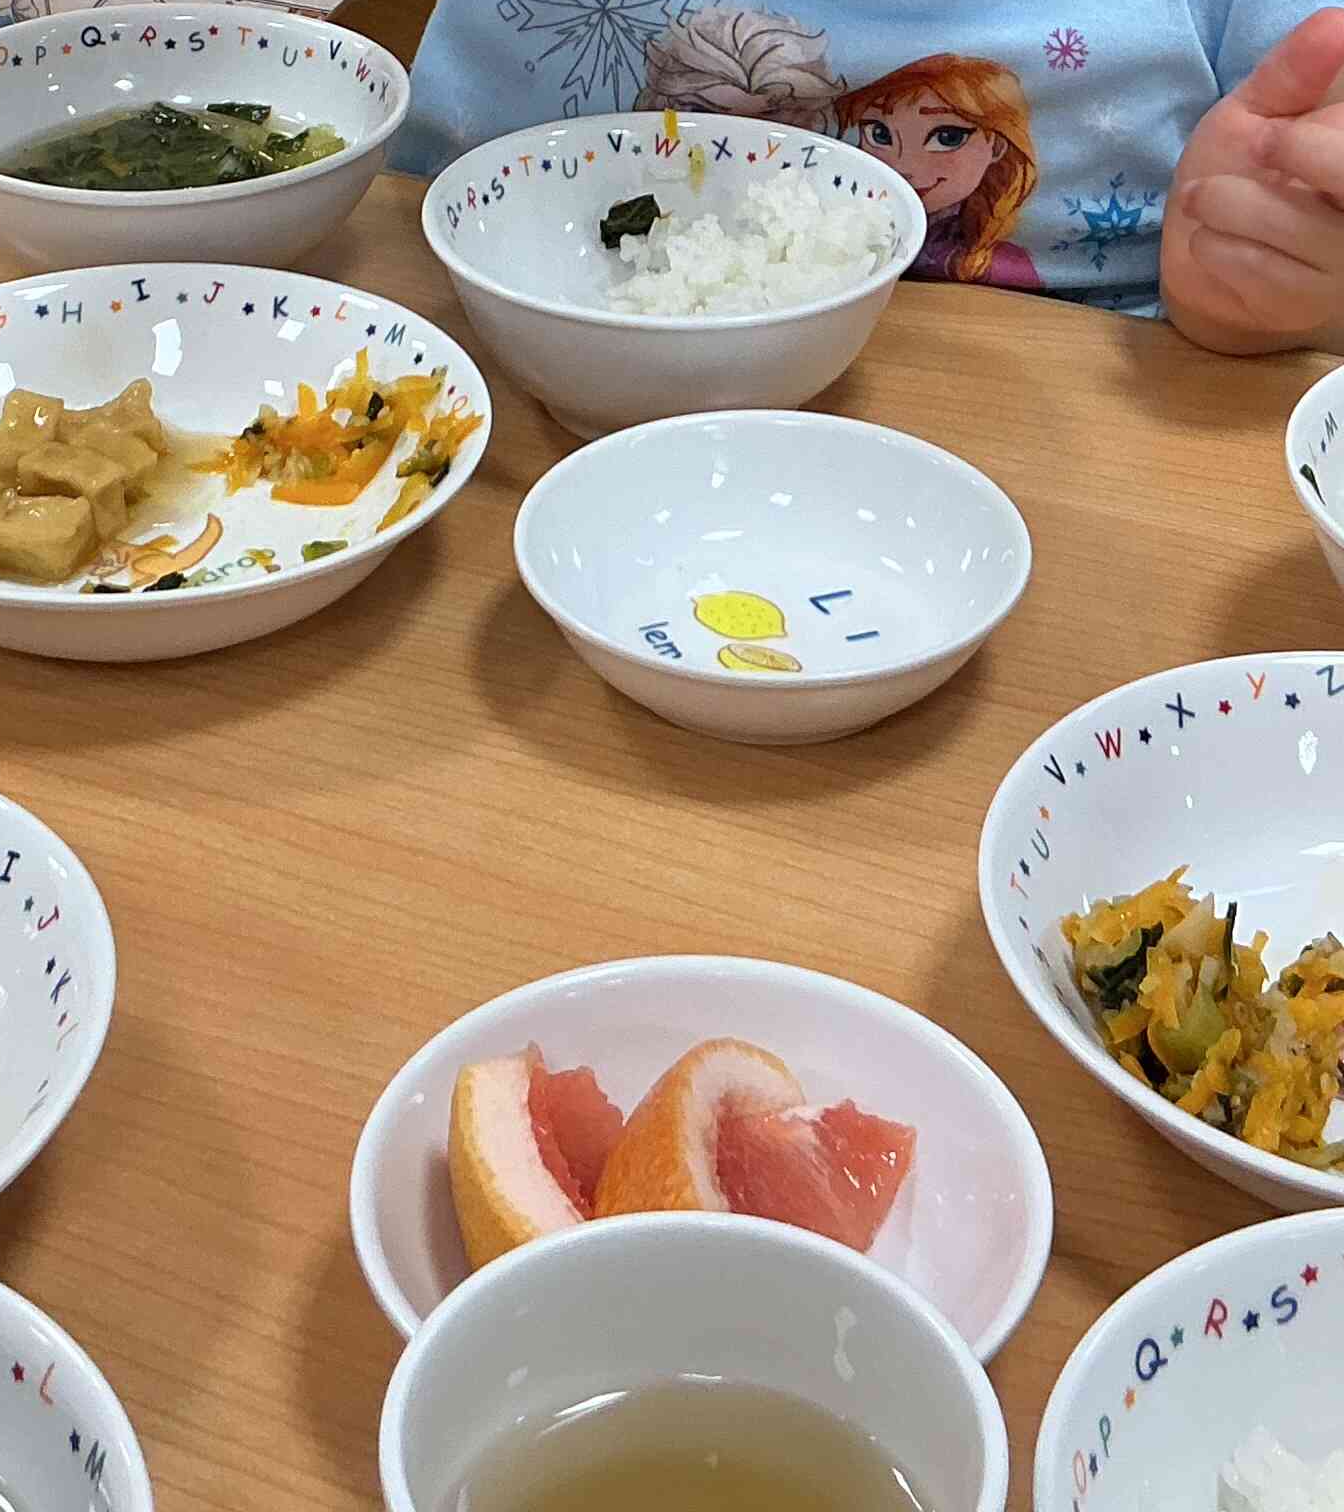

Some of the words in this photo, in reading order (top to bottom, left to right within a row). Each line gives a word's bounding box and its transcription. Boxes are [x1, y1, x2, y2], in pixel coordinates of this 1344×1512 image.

[36, 46, 46, 65] P
[81, 26, 106, 48] Q
[139, 26, 156, 47] R
[189, 32, 205, 52] S
[237, 27, 252, 46] T
[283, 46, 298, 67] U
[330, 40, 342, 60] V
[467, 187, 476, 209] R
[491, 177, 504, 200] S
[518, 156, 533, 176] T
[562, 157, 577, 179] U
[607, 133, 622, 153] V
[655, 136, 680, 157] W
[712, 137, 732, 161] X
[766, 139, 780, 159] Y
[801, 145, 817, 168] Z
[62, 301, 82, 324] H
[131, 278, 150, 301] I
[204, 281, 224, 304] J
[273, 296, 288, 319] K
[335, 301, 346, 321] L
[384, 323, 406, 346] M
[809, 590, 852, 615] L
[1044, 754, 1065, 784] V
[1095, 728, 1121, 759] W
[1166, 693, 1195, 728] X
[1246, 673, 1265, 700] Y
[0, 851, 20, 883] I
[1135, 1338, 1168, 1382] Q
[1204, 1299, 1227, 1339] R
[1271, 1285, 1298, 1325] S
